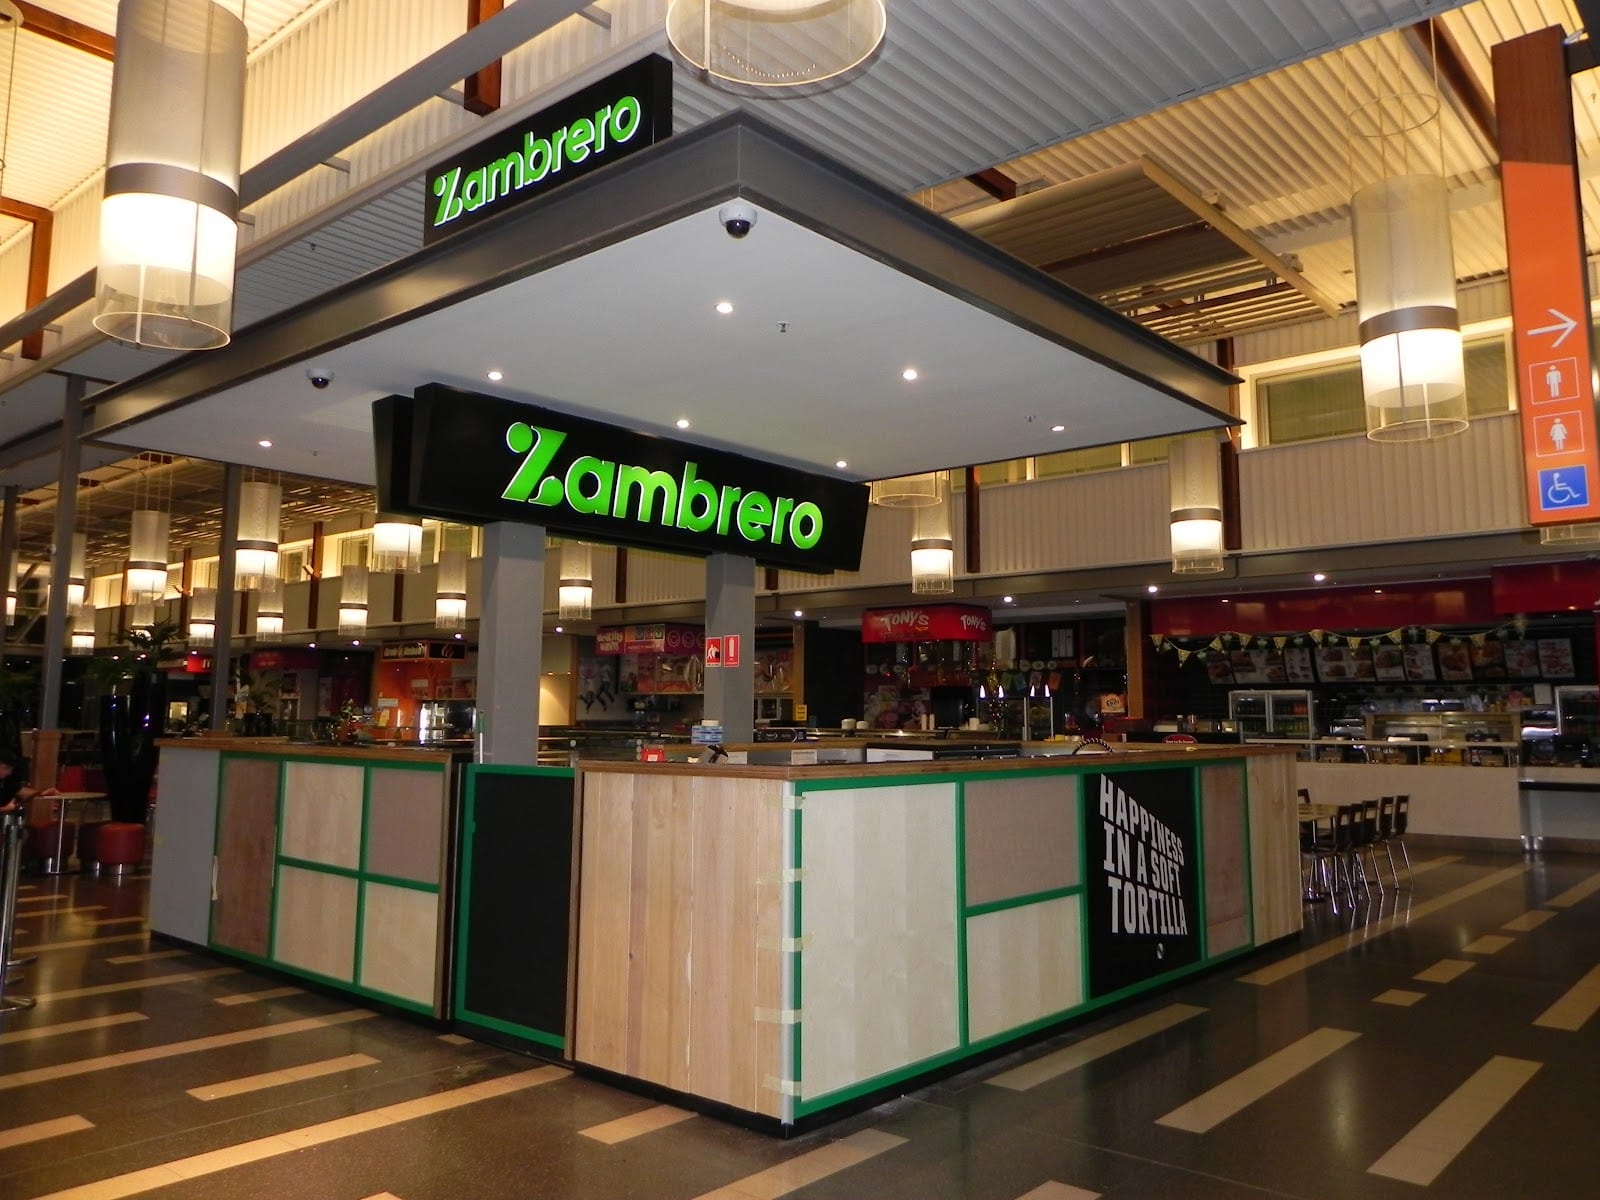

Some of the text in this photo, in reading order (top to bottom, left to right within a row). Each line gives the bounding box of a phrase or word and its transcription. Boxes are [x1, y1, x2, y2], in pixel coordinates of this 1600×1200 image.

[433, 96, 641, 226] Zambrero
[501, 421, 823, 549] Zambrero
[1100, 773, 1185, 867] HAPPINESS
[1103, 820, 1181, 897] IN A SOFT
[1108, 875, 1188, 935] TORTILLA
